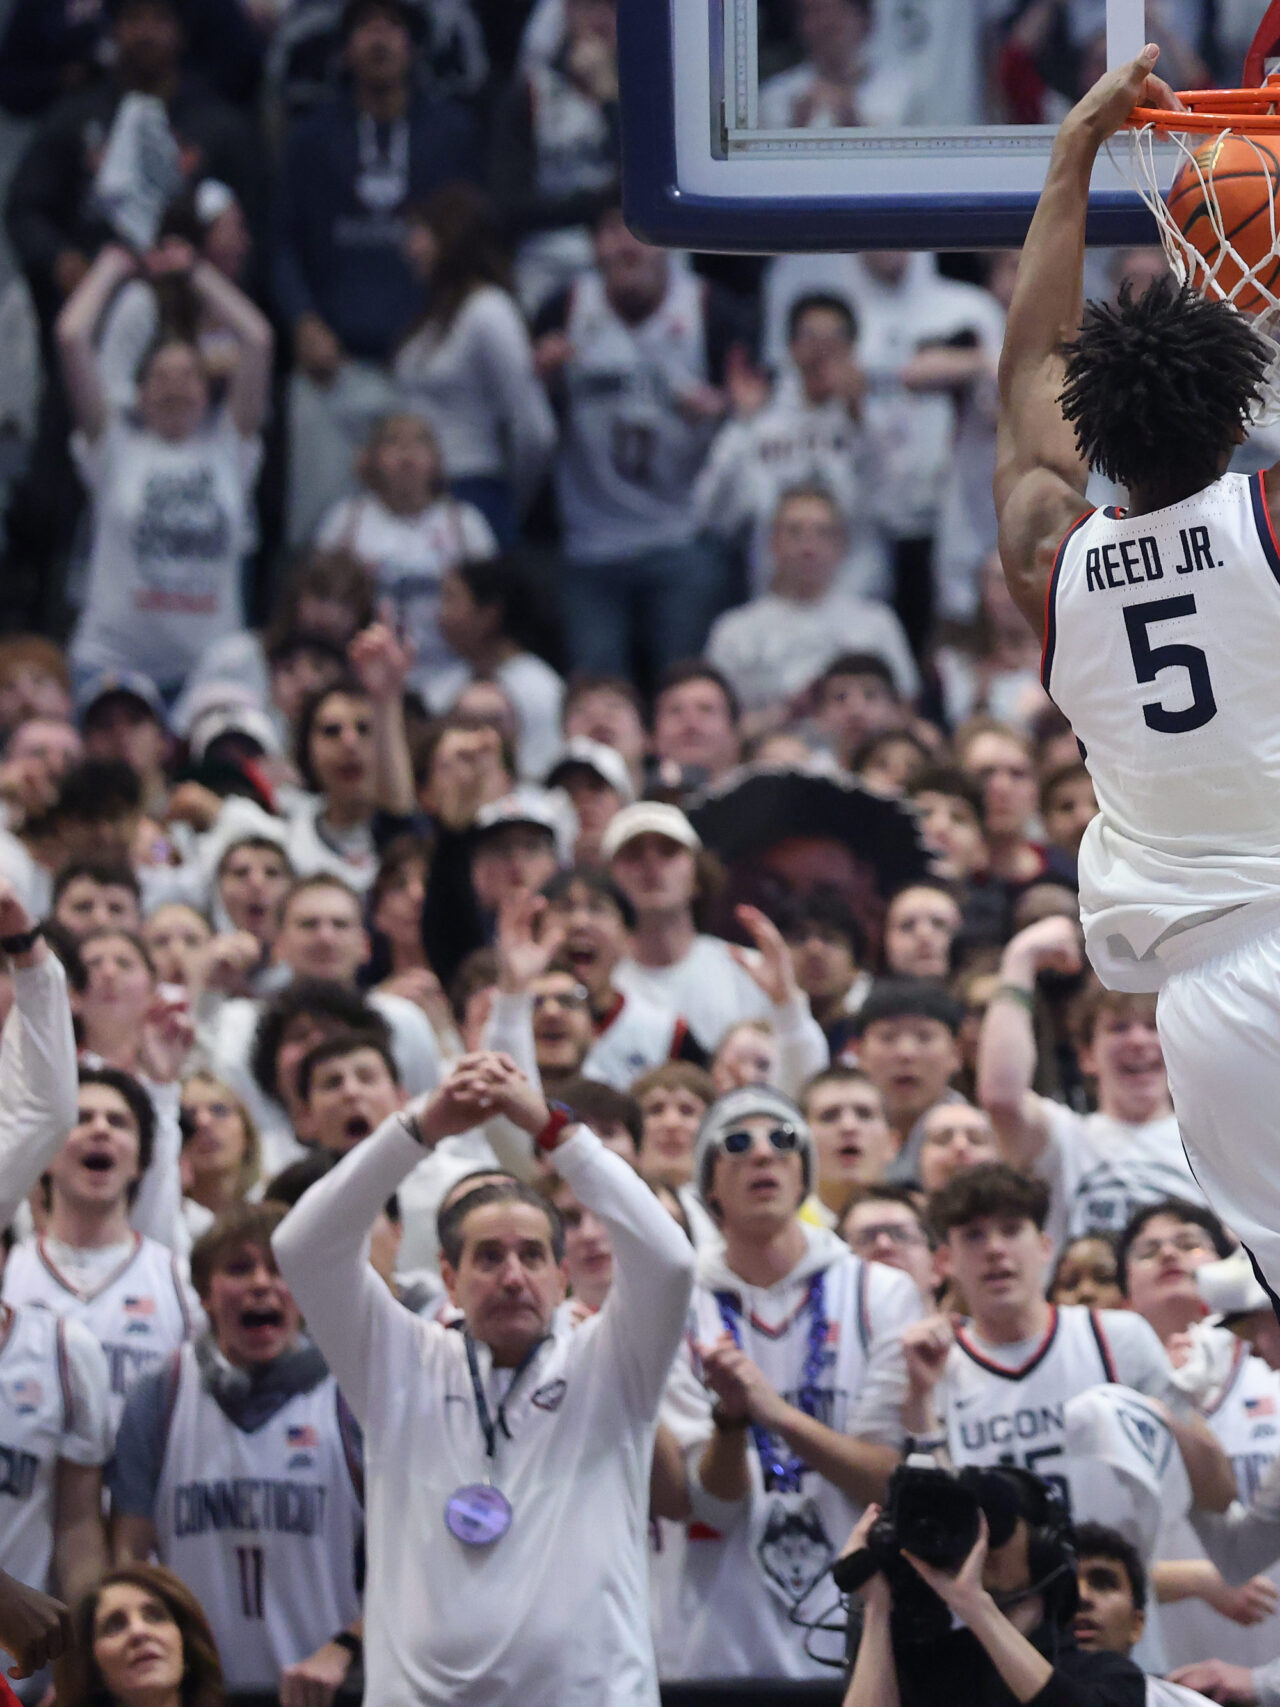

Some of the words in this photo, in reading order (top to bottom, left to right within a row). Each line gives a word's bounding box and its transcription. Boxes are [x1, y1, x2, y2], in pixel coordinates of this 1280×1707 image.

[1086, 536, 1164, 592] REED
[1176, 525, 1224, 574] JR.
[1122, 593, 1218, 733] 5
[961, 1402, 1065, 1449] UCON
[235, 1547, 264, 1618] 11
